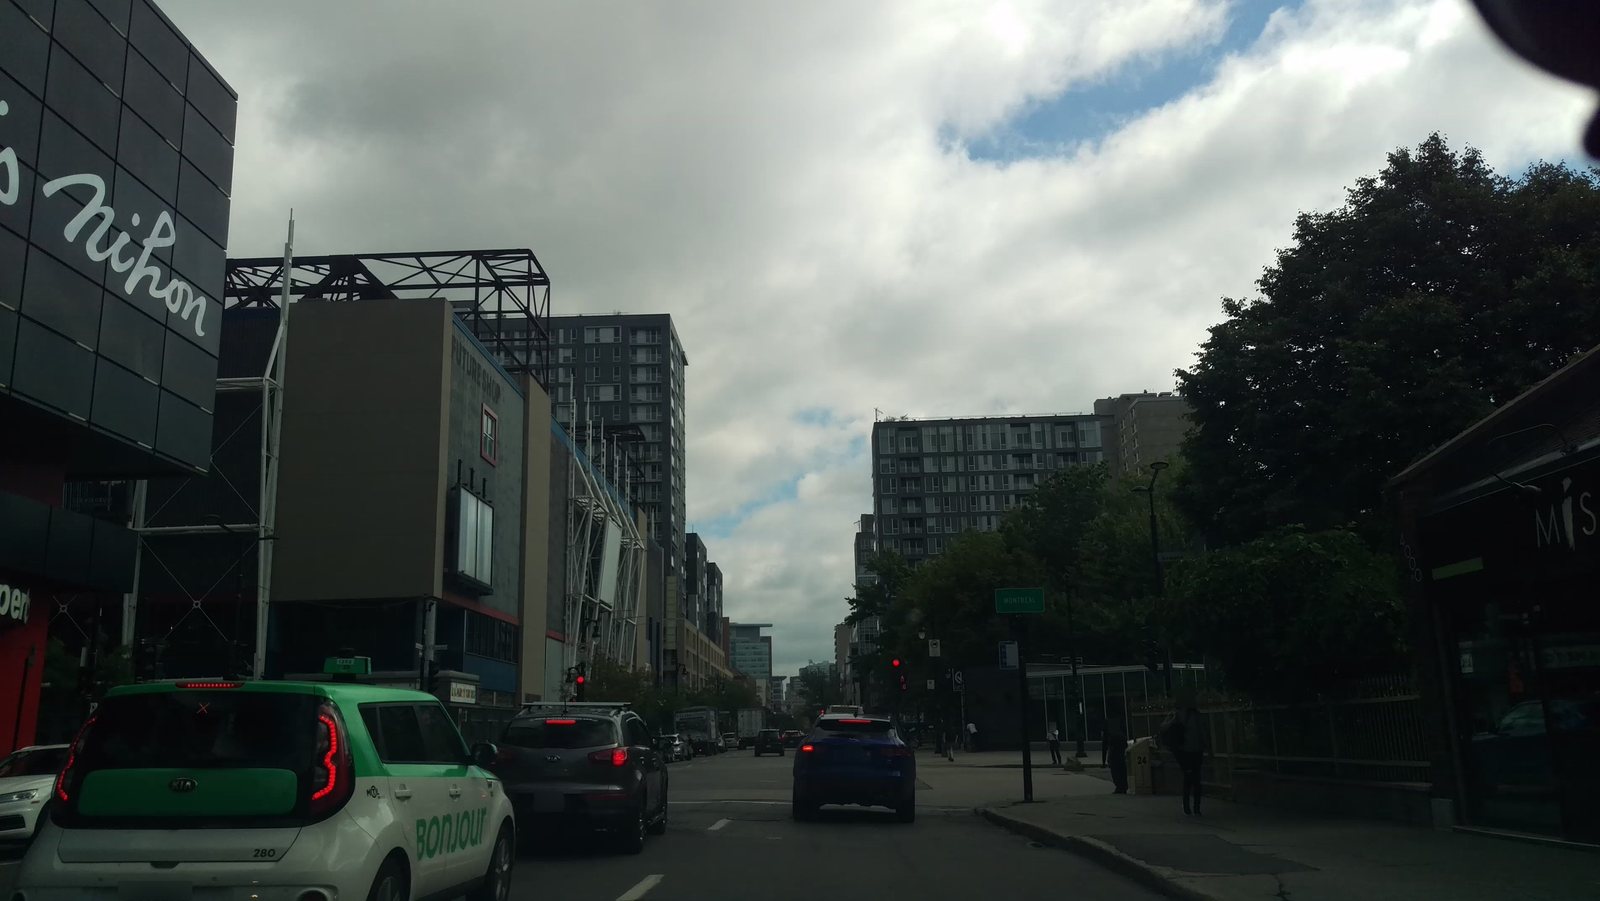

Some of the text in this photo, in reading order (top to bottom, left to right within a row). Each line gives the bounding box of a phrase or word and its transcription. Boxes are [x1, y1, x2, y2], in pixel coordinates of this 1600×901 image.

[482, 368, 501, 405] SHOP
[1137, 755, 1148, 766] 24
[252, 847, 277, 859] 280
